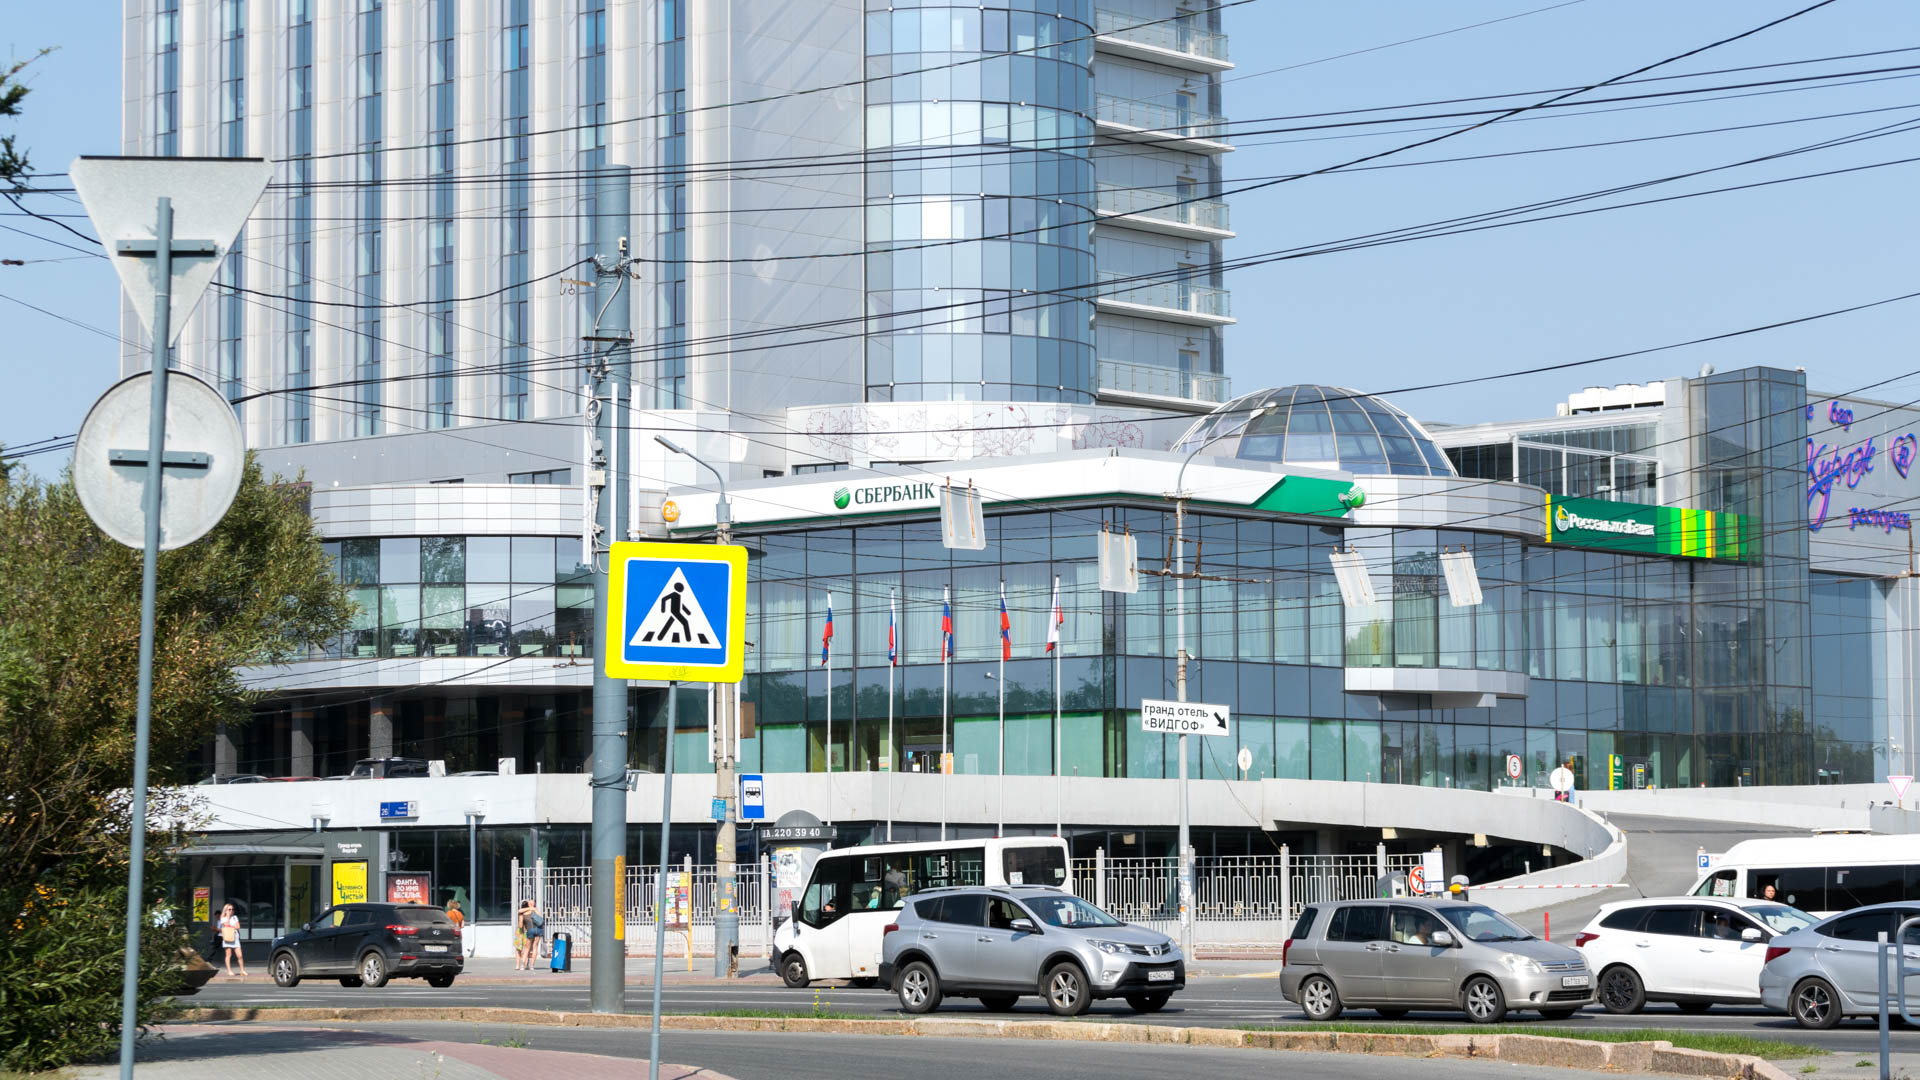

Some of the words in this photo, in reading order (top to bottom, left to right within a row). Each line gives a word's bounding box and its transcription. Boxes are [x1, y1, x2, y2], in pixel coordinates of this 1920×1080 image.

[1829, 401, 1854, 431] бар
[854, 482, 935, 505] СБЕРБАНК
[1849, 506, 1911, 533] ресторан
[1144, 705, 1175, 717] гранд
[1177, 707, 1209, 718] отель
[1144, 717, 1205, 732] «ВИДГОФ»
[795, 828, 807, 837] 39
[809, 828, 820, 837] 40
